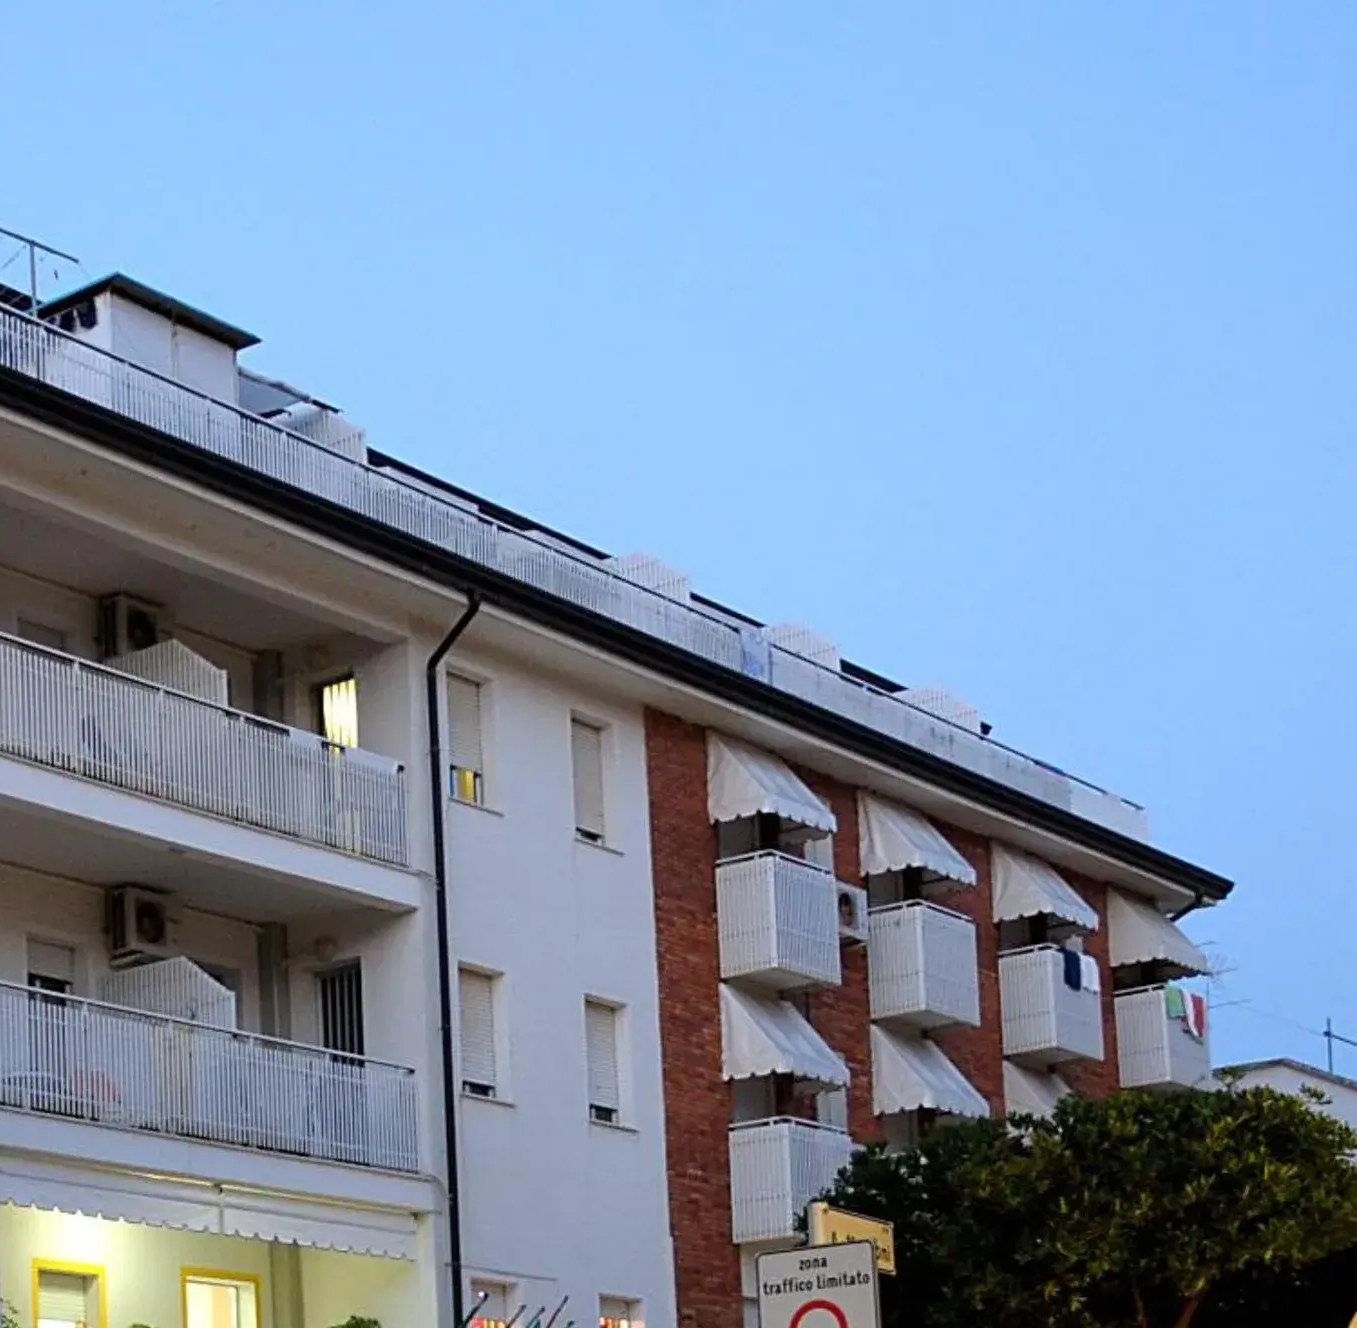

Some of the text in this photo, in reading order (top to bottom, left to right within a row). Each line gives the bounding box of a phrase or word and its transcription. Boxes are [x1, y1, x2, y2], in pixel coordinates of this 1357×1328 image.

[799, 1256, 828, 1271] zona
[763, 1271, 871, 1295] traffico limitato
